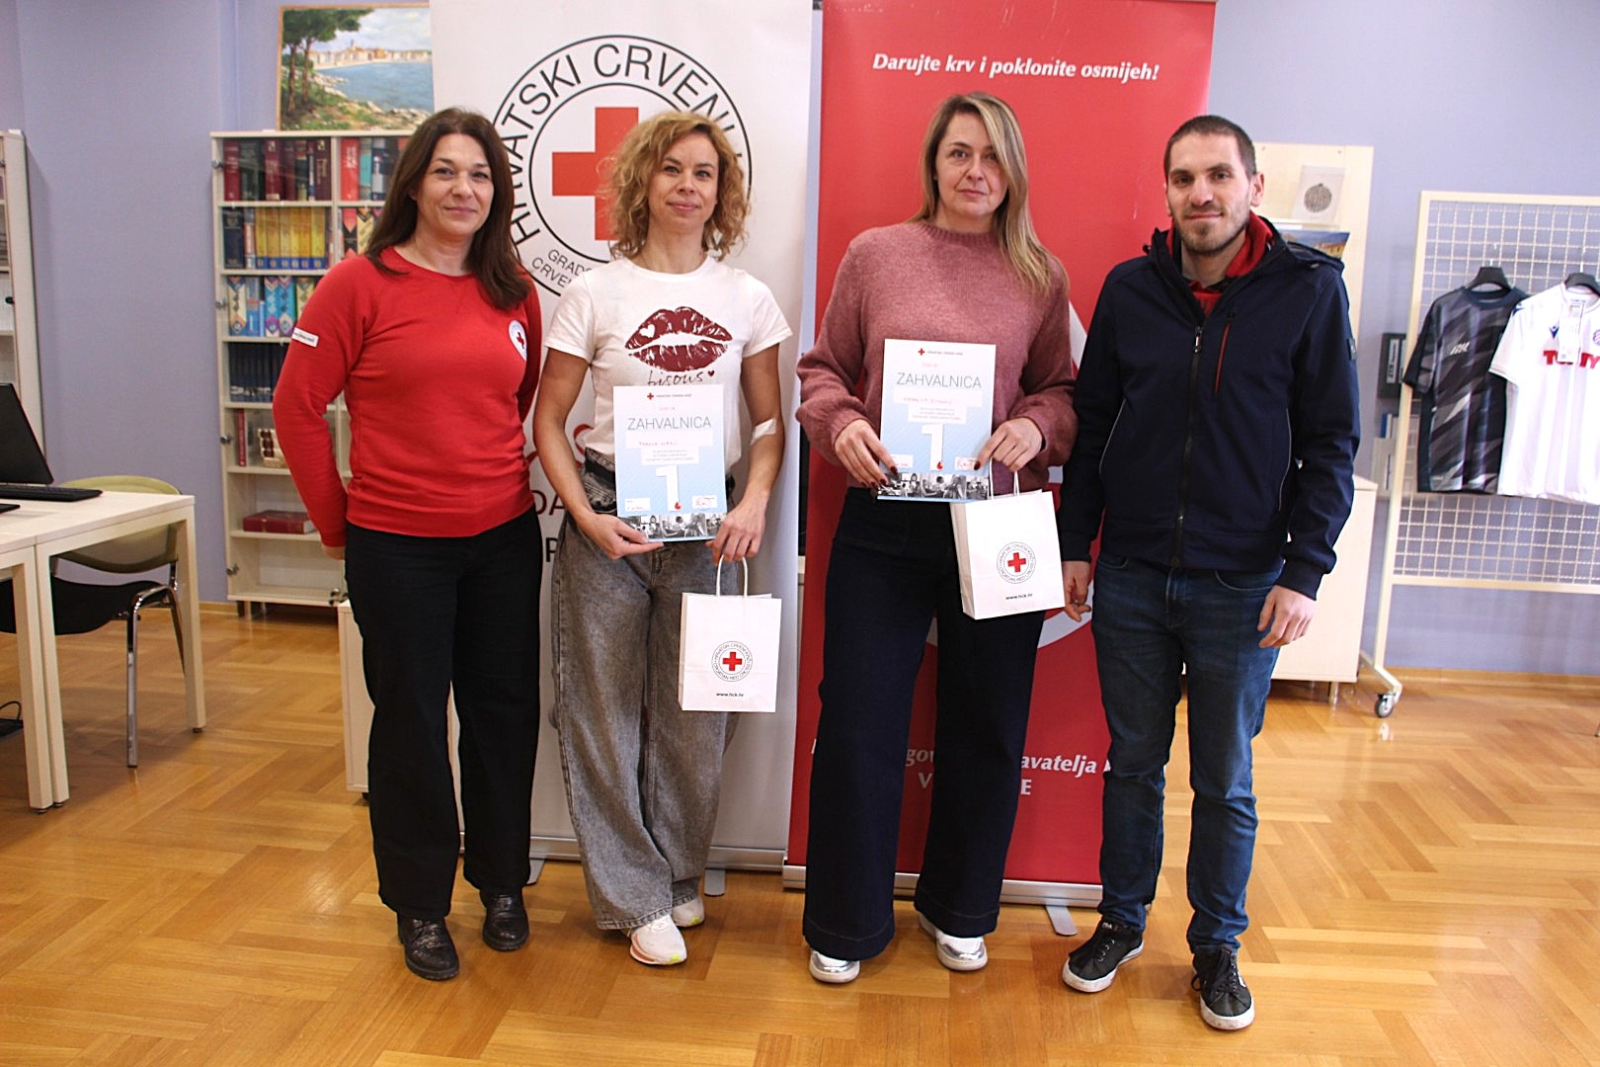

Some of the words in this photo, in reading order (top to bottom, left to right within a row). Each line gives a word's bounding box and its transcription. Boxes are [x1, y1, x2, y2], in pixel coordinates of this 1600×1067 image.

[872, 53, 941, 76] Darujte
[945, 55, 976, 73] krv
[979, 56, 987, 73] i
[989, 57, 1076, 79] poklonite
[1081, 62, 1160, 84] osmijeh!
[531, 257, 572, 288] CRVE
[896, 371, 982, 389] ZAHVALNICA
[627, 415, 712, 431] ZAHVALNICA
